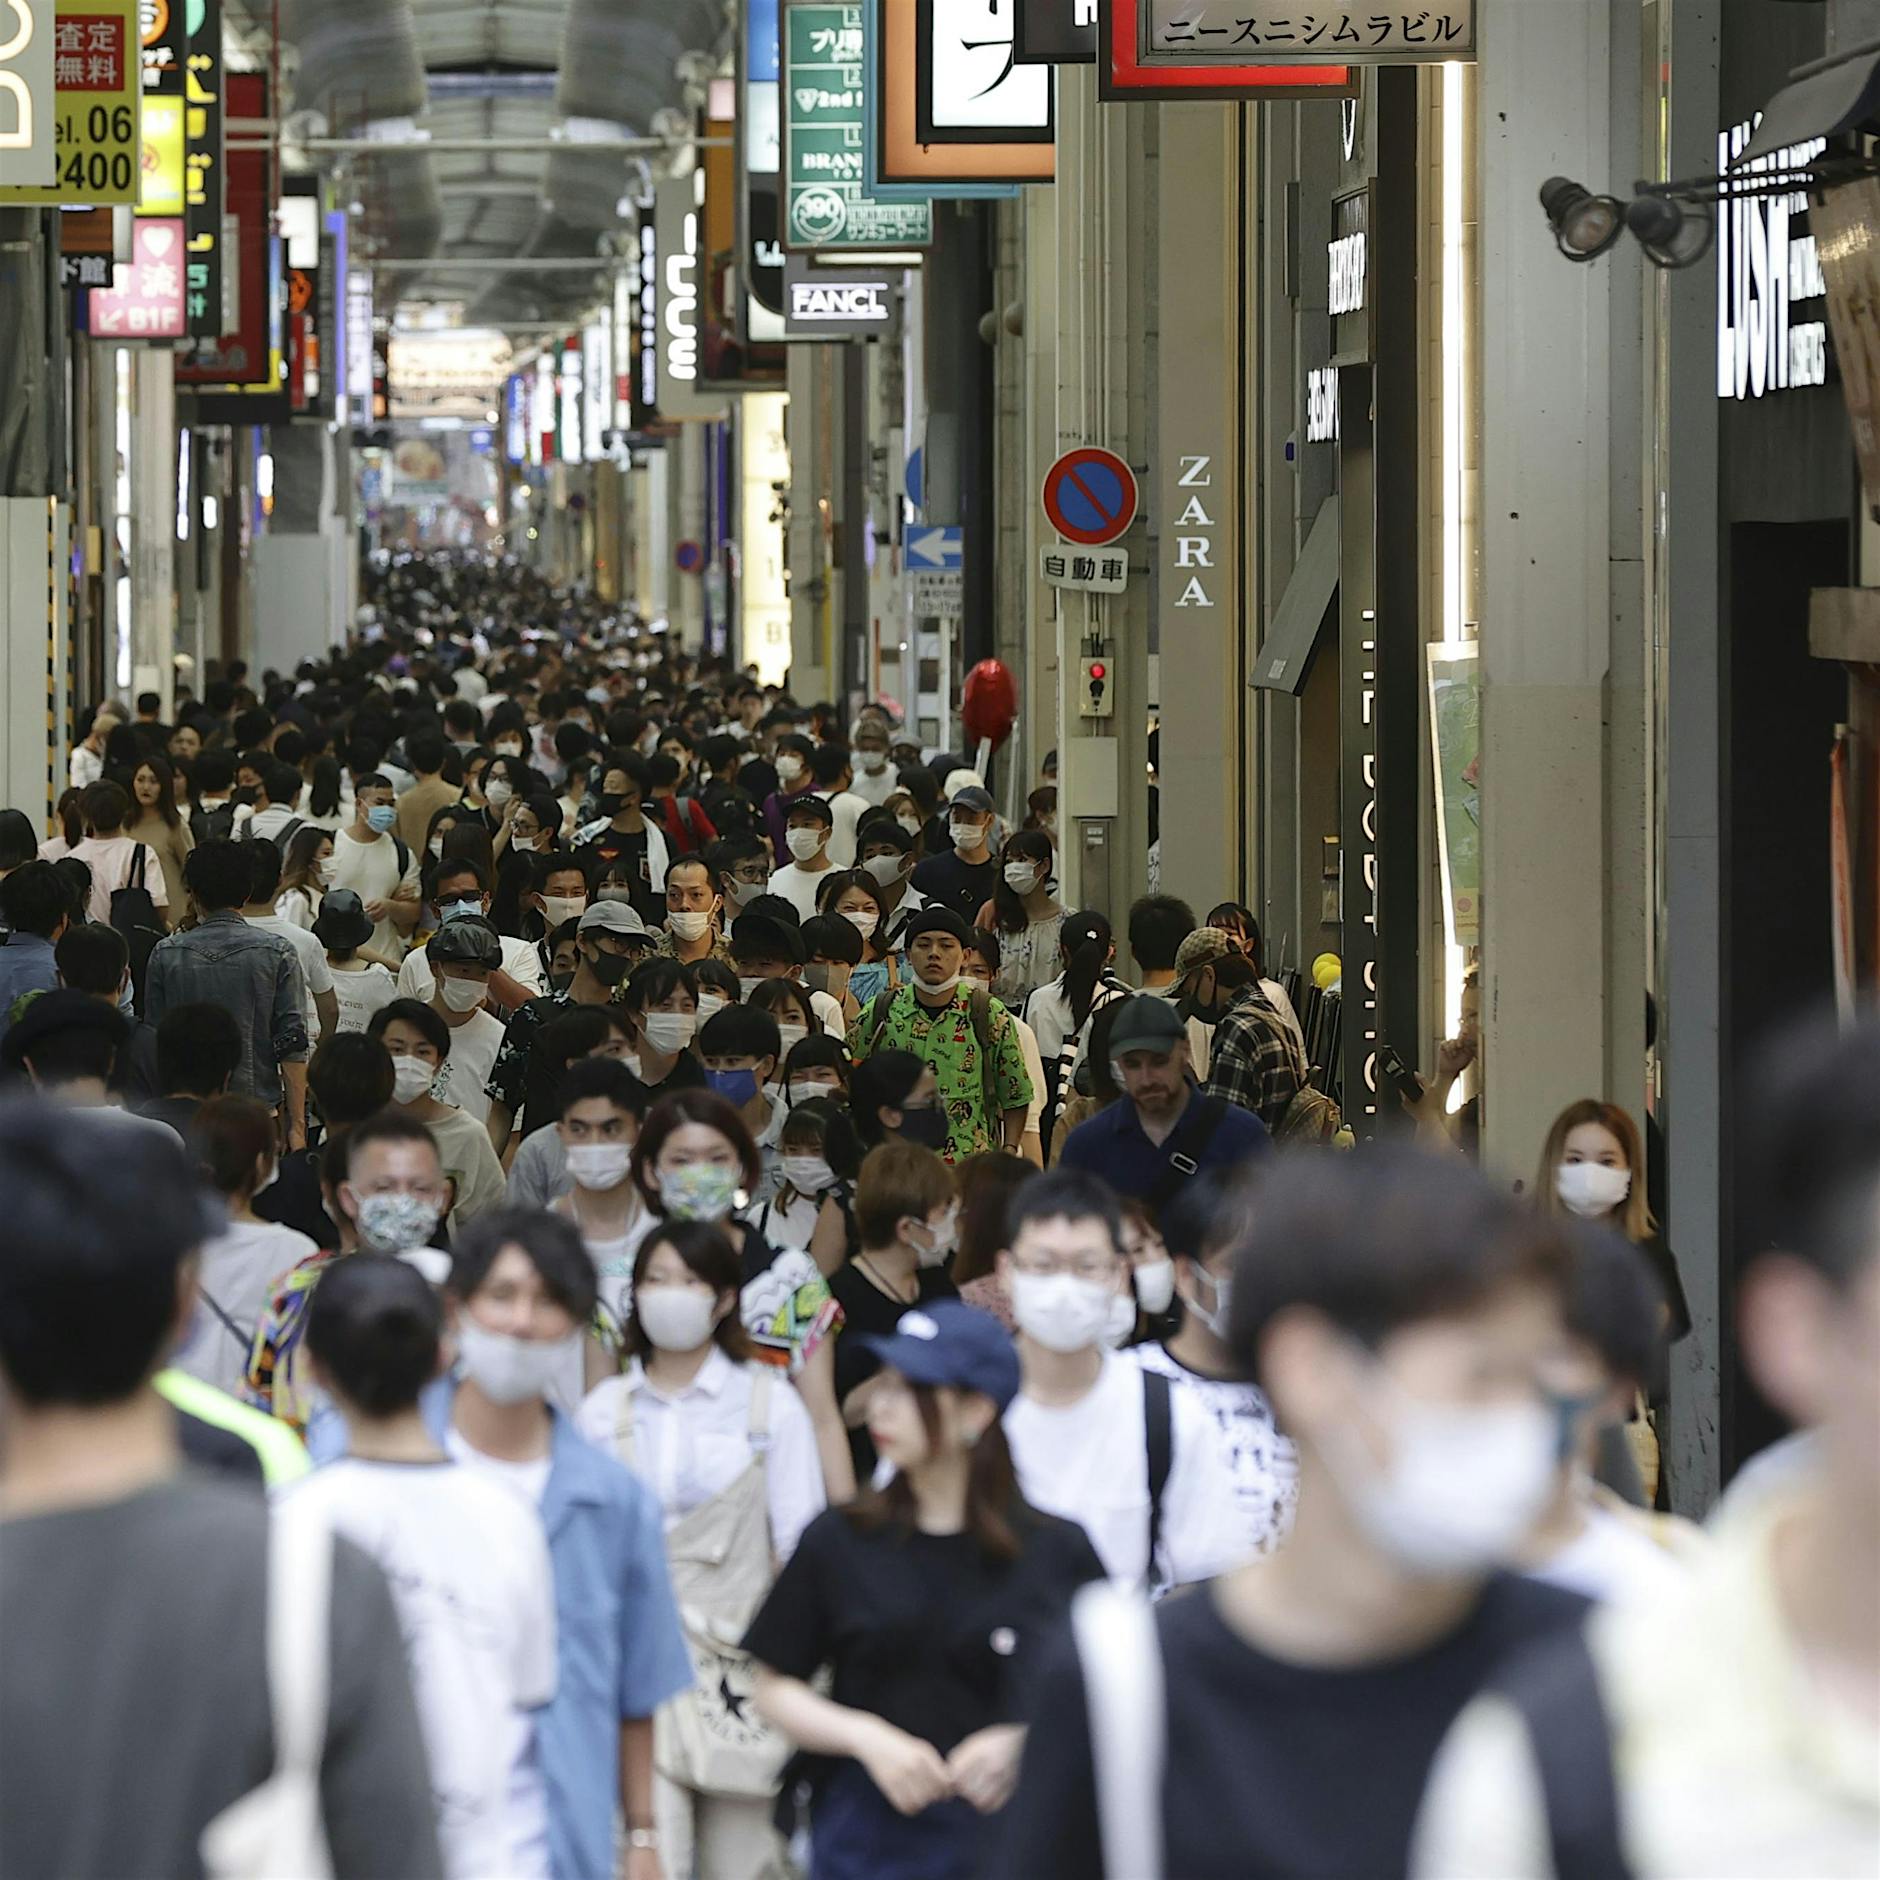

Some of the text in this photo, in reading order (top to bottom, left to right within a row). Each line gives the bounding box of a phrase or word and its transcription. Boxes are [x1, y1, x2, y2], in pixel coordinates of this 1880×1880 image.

[57, 22, 116, 52] 査定
[1164, 12, 1465, 46] ニースニシムラビル
[57, 55, 116, 85] 無料
[88, 106, 132, 144] 06
[802, 153, 862, 169] BRAN
[799, 197, 838, 219] 390
[1718, 111, 1790, 400] LUSH
[793, 287, 887, 314] FANCL
[128, 306, 179, 331] B1F
[1174, 456, 1215, 607] ZARA
[1046, 556, 1124, 583] 自動車
